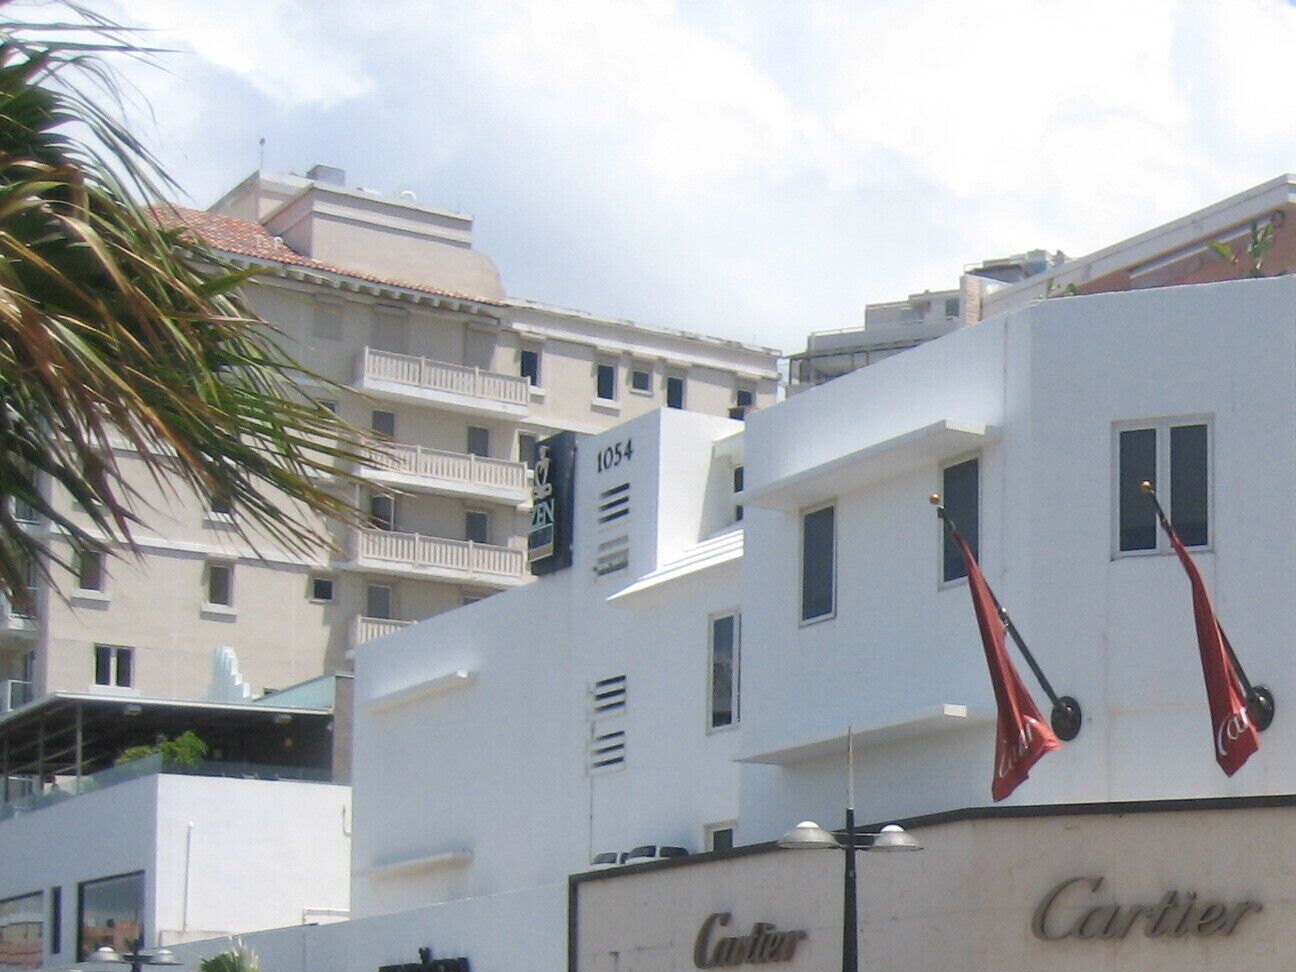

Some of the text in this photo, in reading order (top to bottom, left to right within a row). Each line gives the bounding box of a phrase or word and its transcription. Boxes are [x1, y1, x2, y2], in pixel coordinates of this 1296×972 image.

[597, 438, 633, 473] 1054
[1032, 876, 1264, 941] Cartier
[693, 911, 807, 969] Cartier
